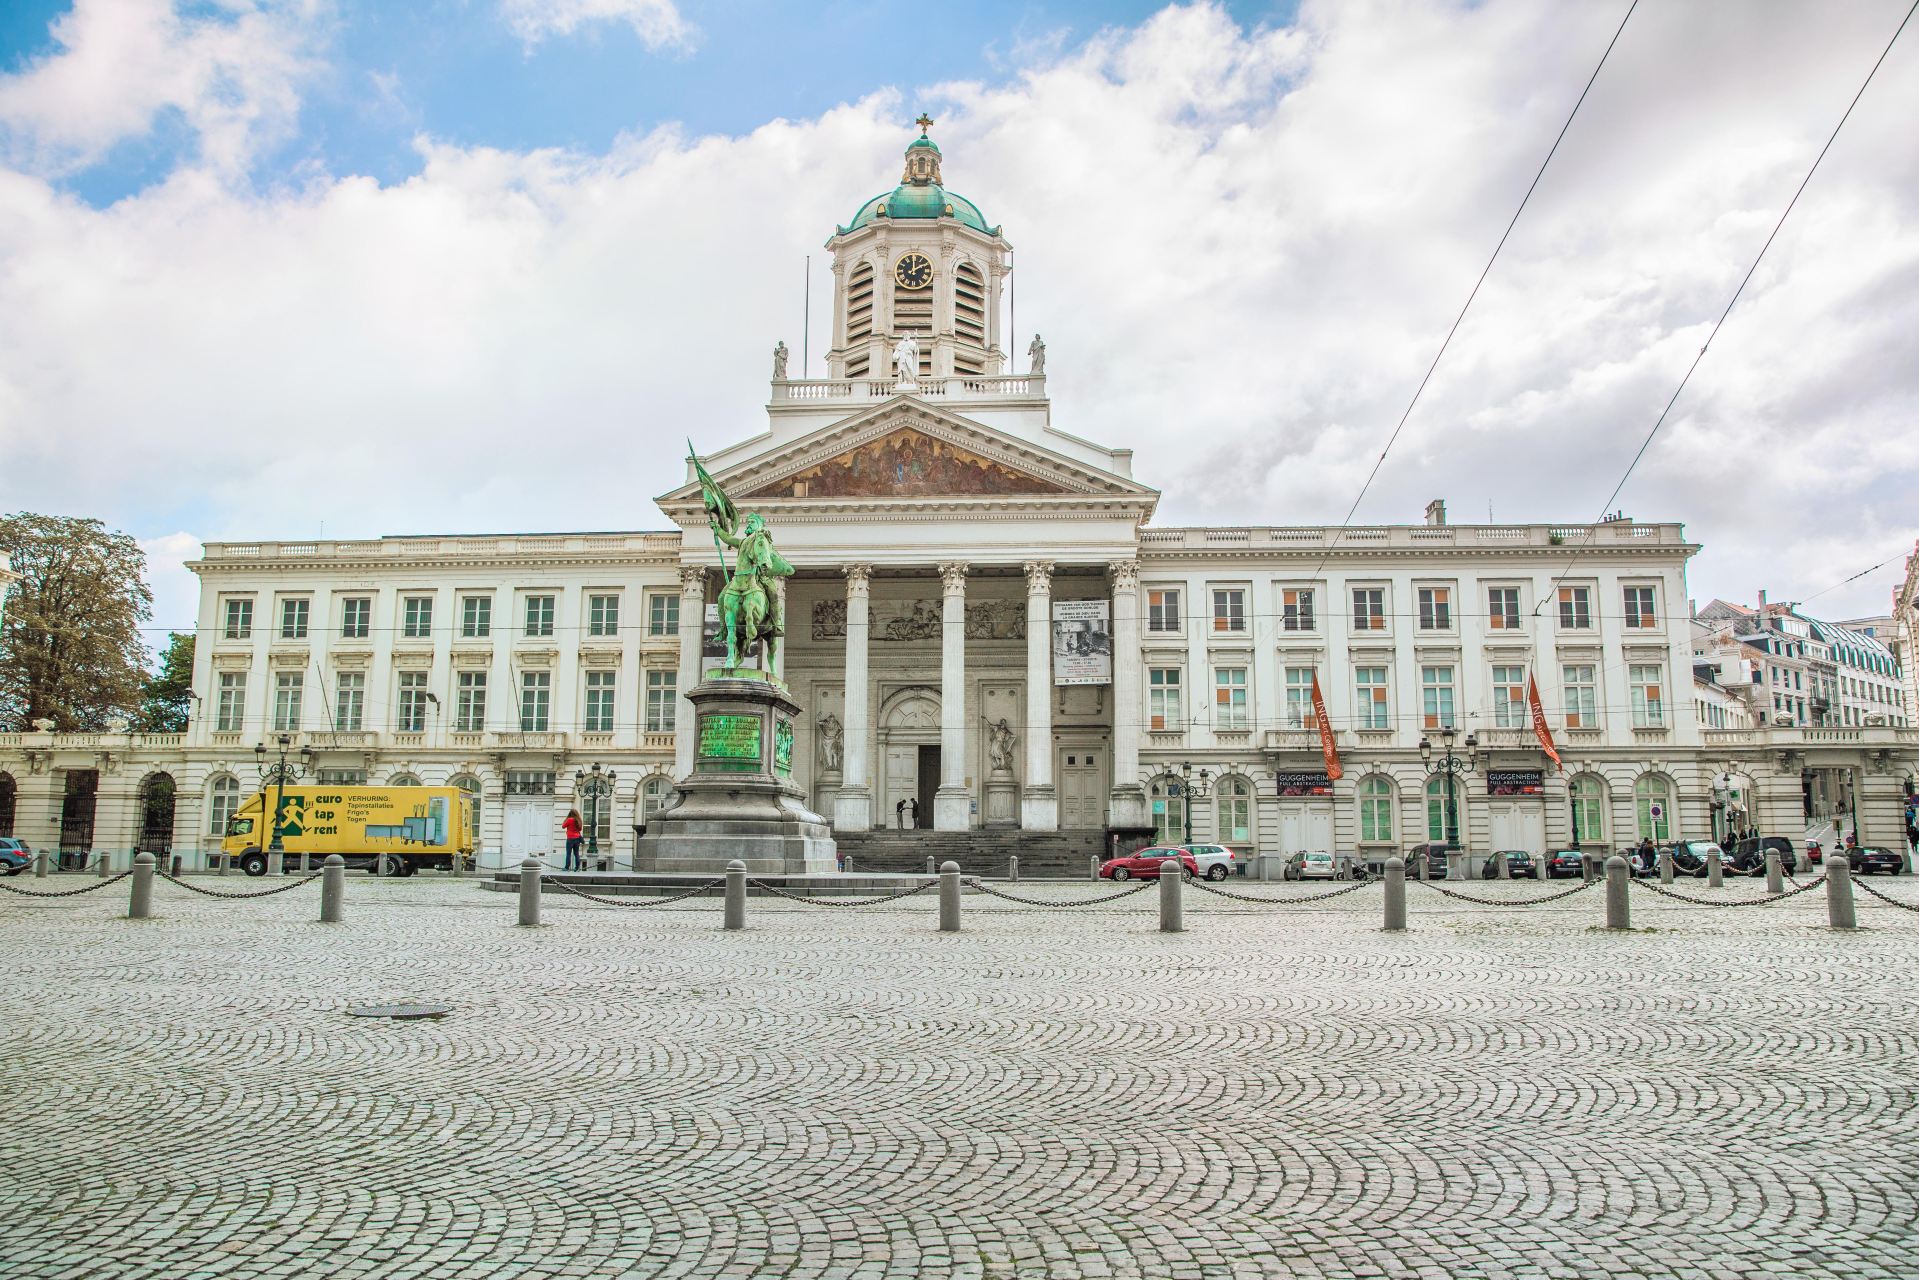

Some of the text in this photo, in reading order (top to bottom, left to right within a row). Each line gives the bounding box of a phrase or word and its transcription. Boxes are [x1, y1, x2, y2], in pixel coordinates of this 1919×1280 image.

[1316, 701, 1327, 722] ING
[1533, 702, 1544, 724] ING
[316, 796, 342, 804] euro
[314, 810, 334, 821] tap
[314, 825, 337, 834] rent
